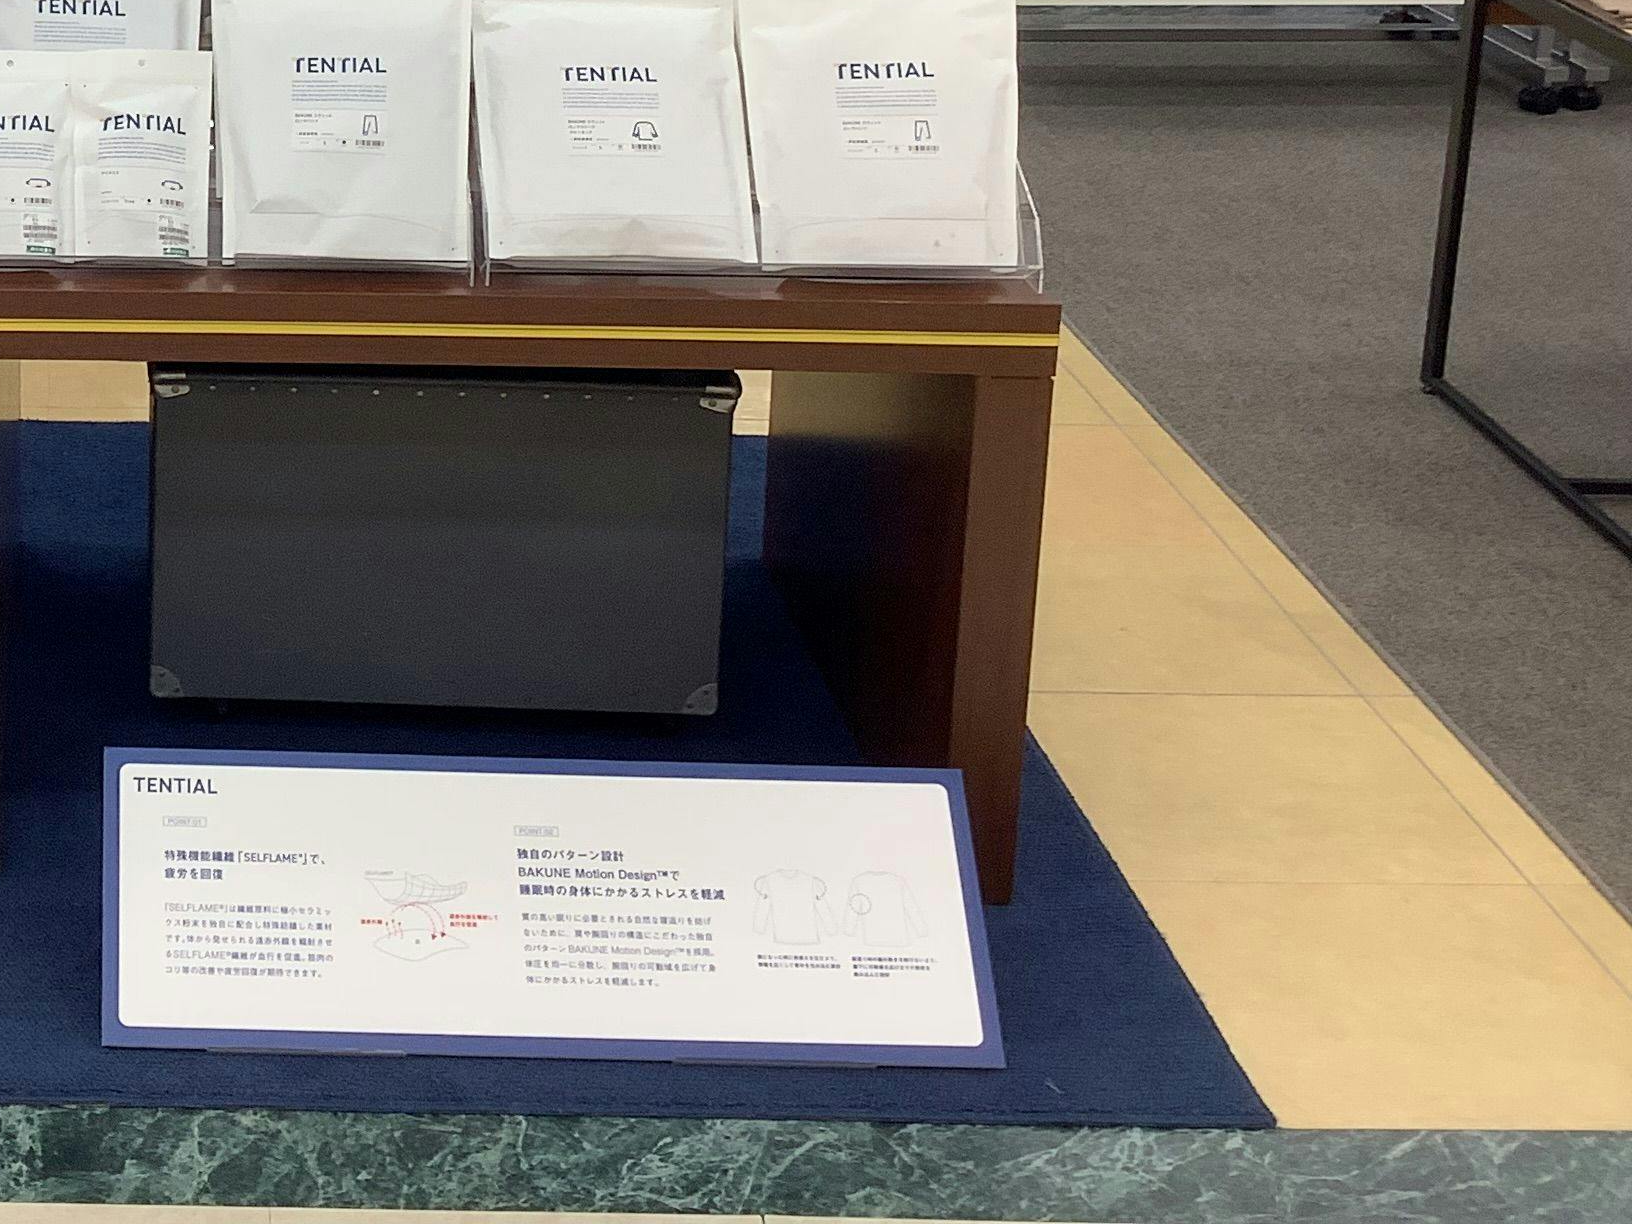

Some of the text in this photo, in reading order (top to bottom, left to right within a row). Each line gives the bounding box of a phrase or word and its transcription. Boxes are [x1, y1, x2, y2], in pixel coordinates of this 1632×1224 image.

[294, 57, 387, 73] TENTIAL
[836, 62, 935, 79] TENTIAL
[562, 66, 658, 82] TENTIAL
[103, 114, 186, 135] TENTIAL
[133, 777, 218, 794] TENTIAL
[517, 848, 624, 862] 独自のパターン設計
[165, 868, 223, 880] 疲労を回復
[518, 867, 571, 879] BAKUNE
[575, 869, 614, 879] Motion
